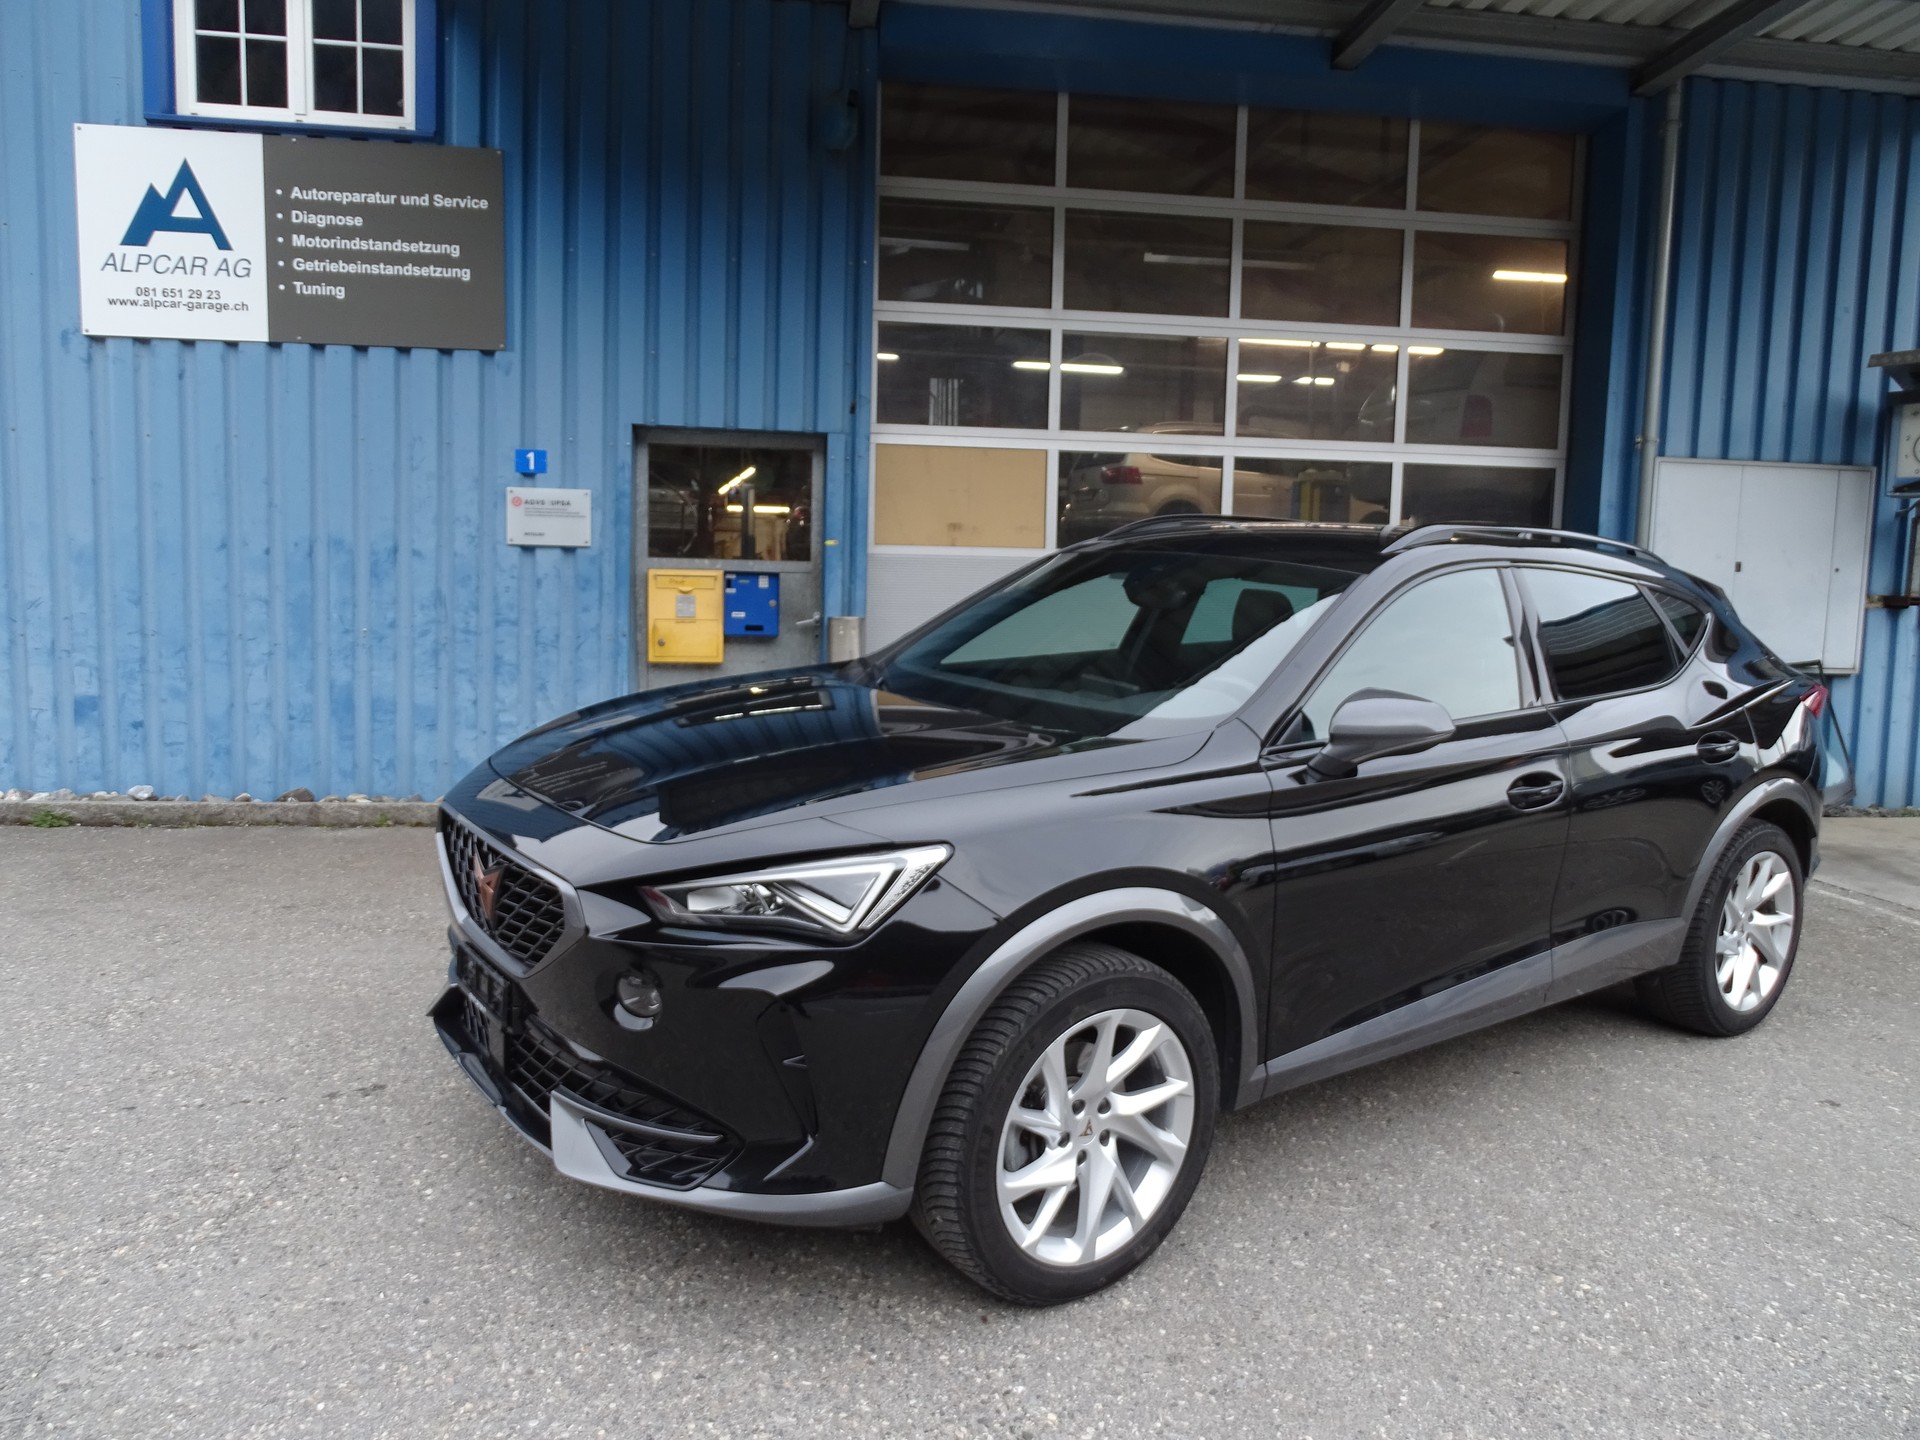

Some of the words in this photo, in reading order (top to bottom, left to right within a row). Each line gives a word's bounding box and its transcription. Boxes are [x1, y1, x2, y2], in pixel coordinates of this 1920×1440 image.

[291, 186, 397, 205] Autoreparatur
[400, 193, 430, 207] und
[433, 193, 489, 209] Service
[291, 209, 364, 228] Diagnose
[292, 233, 460, 257] Motorindstandsetzung
[101, 252, 208, 276] ALPCAR
[214, 257, 252, 278] AG
[292, 257, 471, 281] Getriebeinstandsetzung
[135, 286, 157, 298] 081
[162, 288, 183, 299] 651
[188, 288, 203, 299] 29
[206, 289, 221, 300] 23
[292, 281, 346, 299] Tuning
[107, 297, 250, 313] www.alpcar-garage.ch
[526, 451, 535, 471] 1
